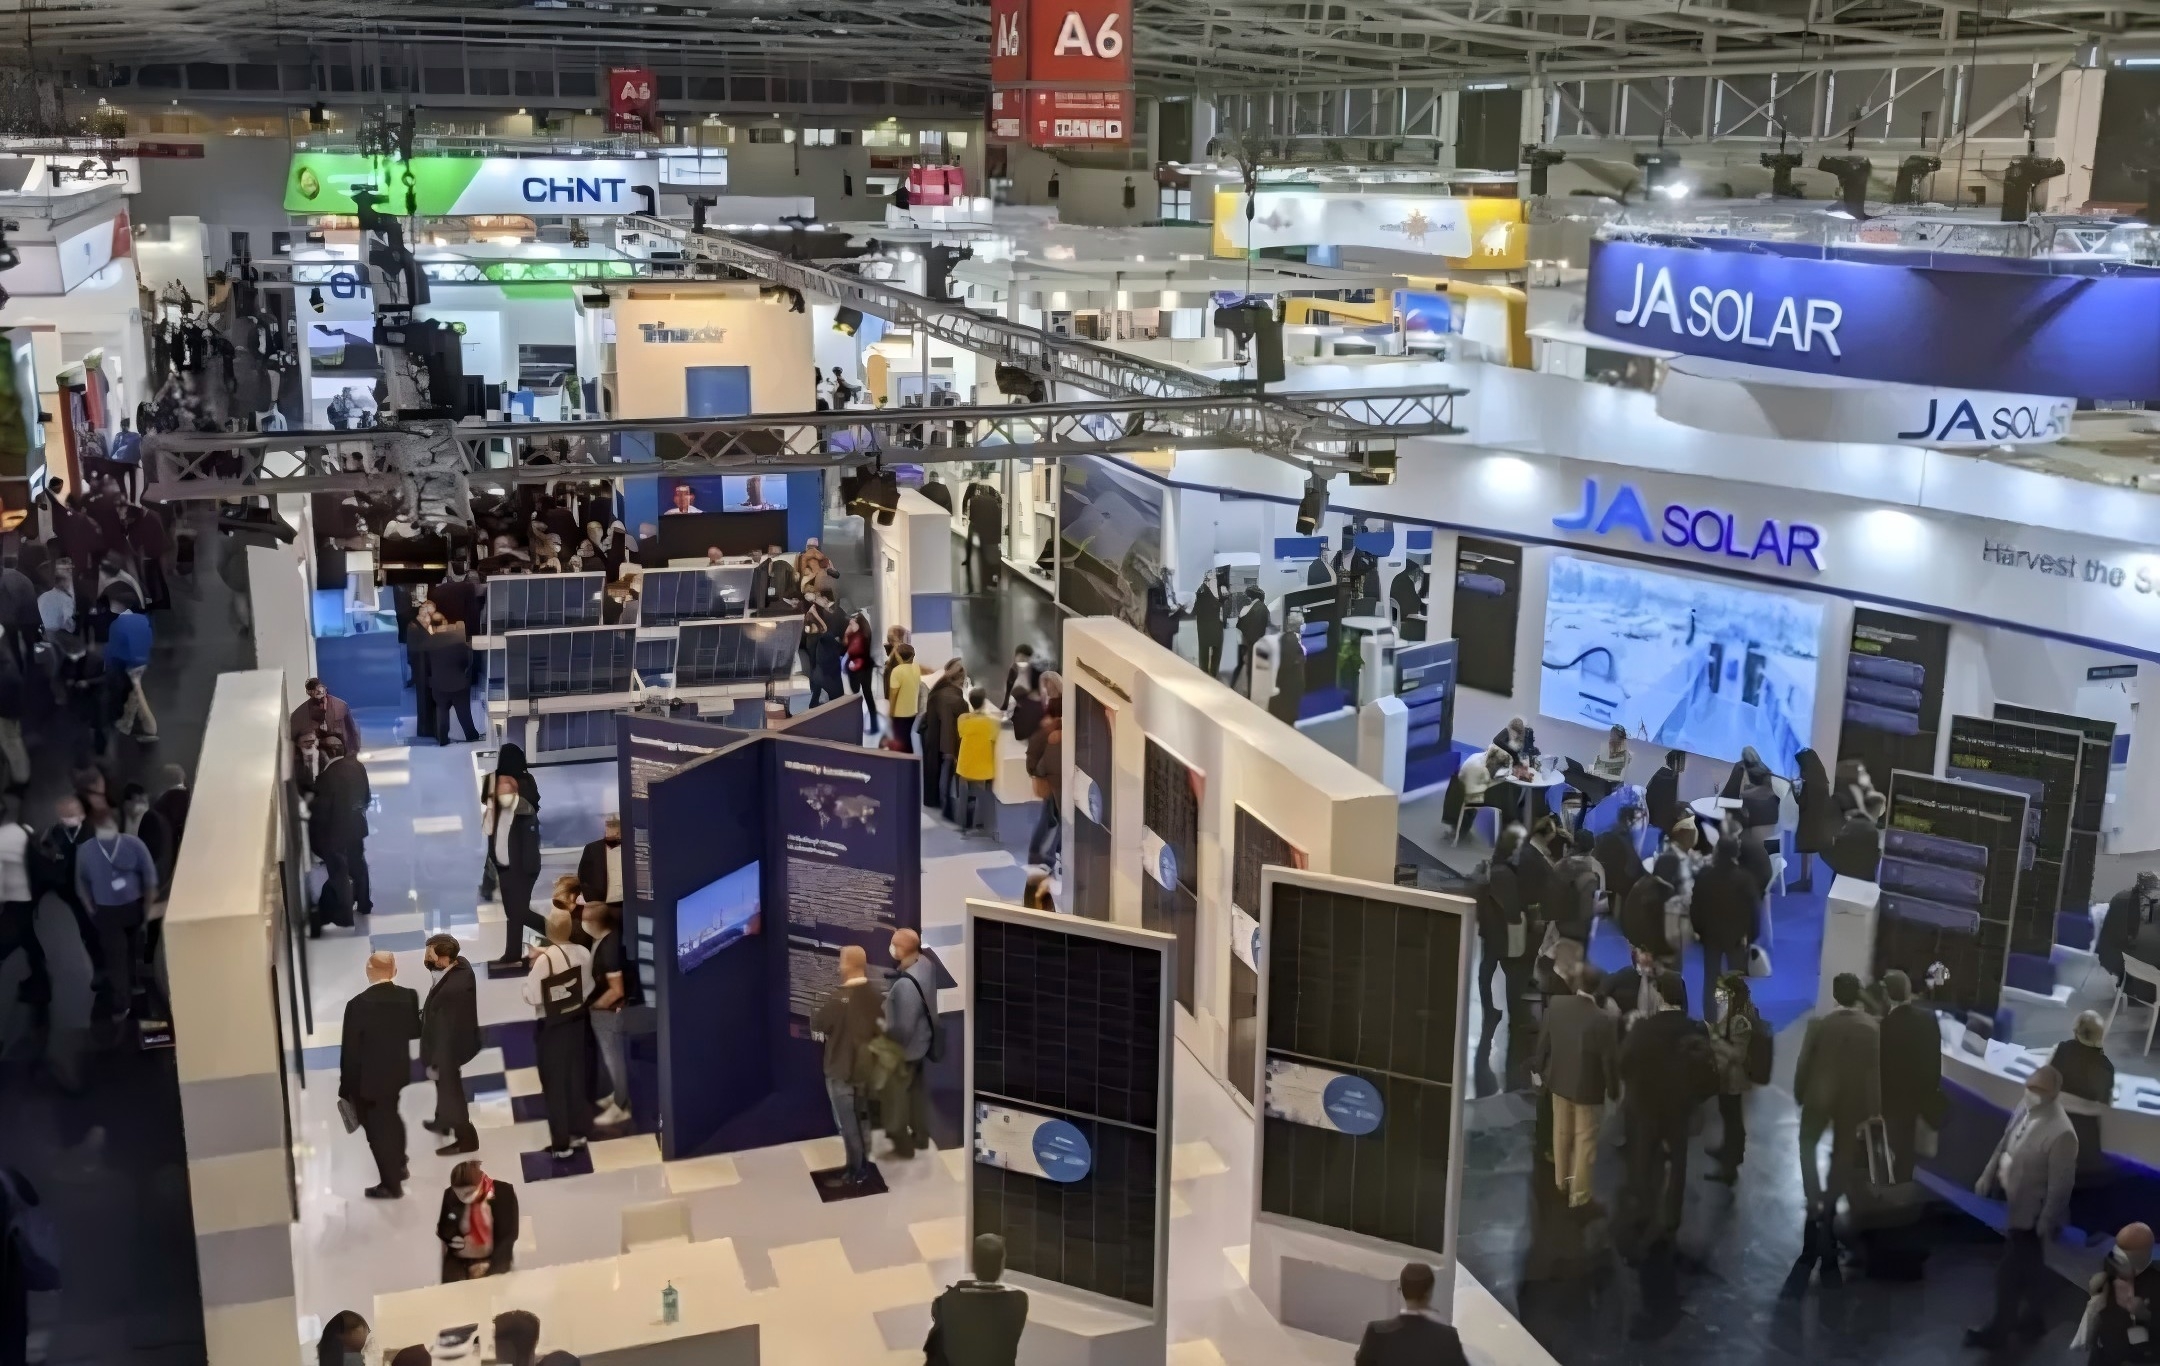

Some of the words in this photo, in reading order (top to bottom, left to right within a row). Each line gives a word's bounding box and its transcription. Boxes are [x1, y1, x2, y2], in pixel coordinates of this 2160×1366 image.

[1054, 11, 1123, 59] A6
[1615, 262, 1685, 335] JA
[1686, 285, 1843, 357] SOLAR
[1897, 398, 1987, 441] JA
[1551, 477, 1656, 543] JA
[1661, 504, 1827, 572] SOLAR
[1982, 537, 2077, 579] Harvest
[2134, 565, 2160, 596] S
